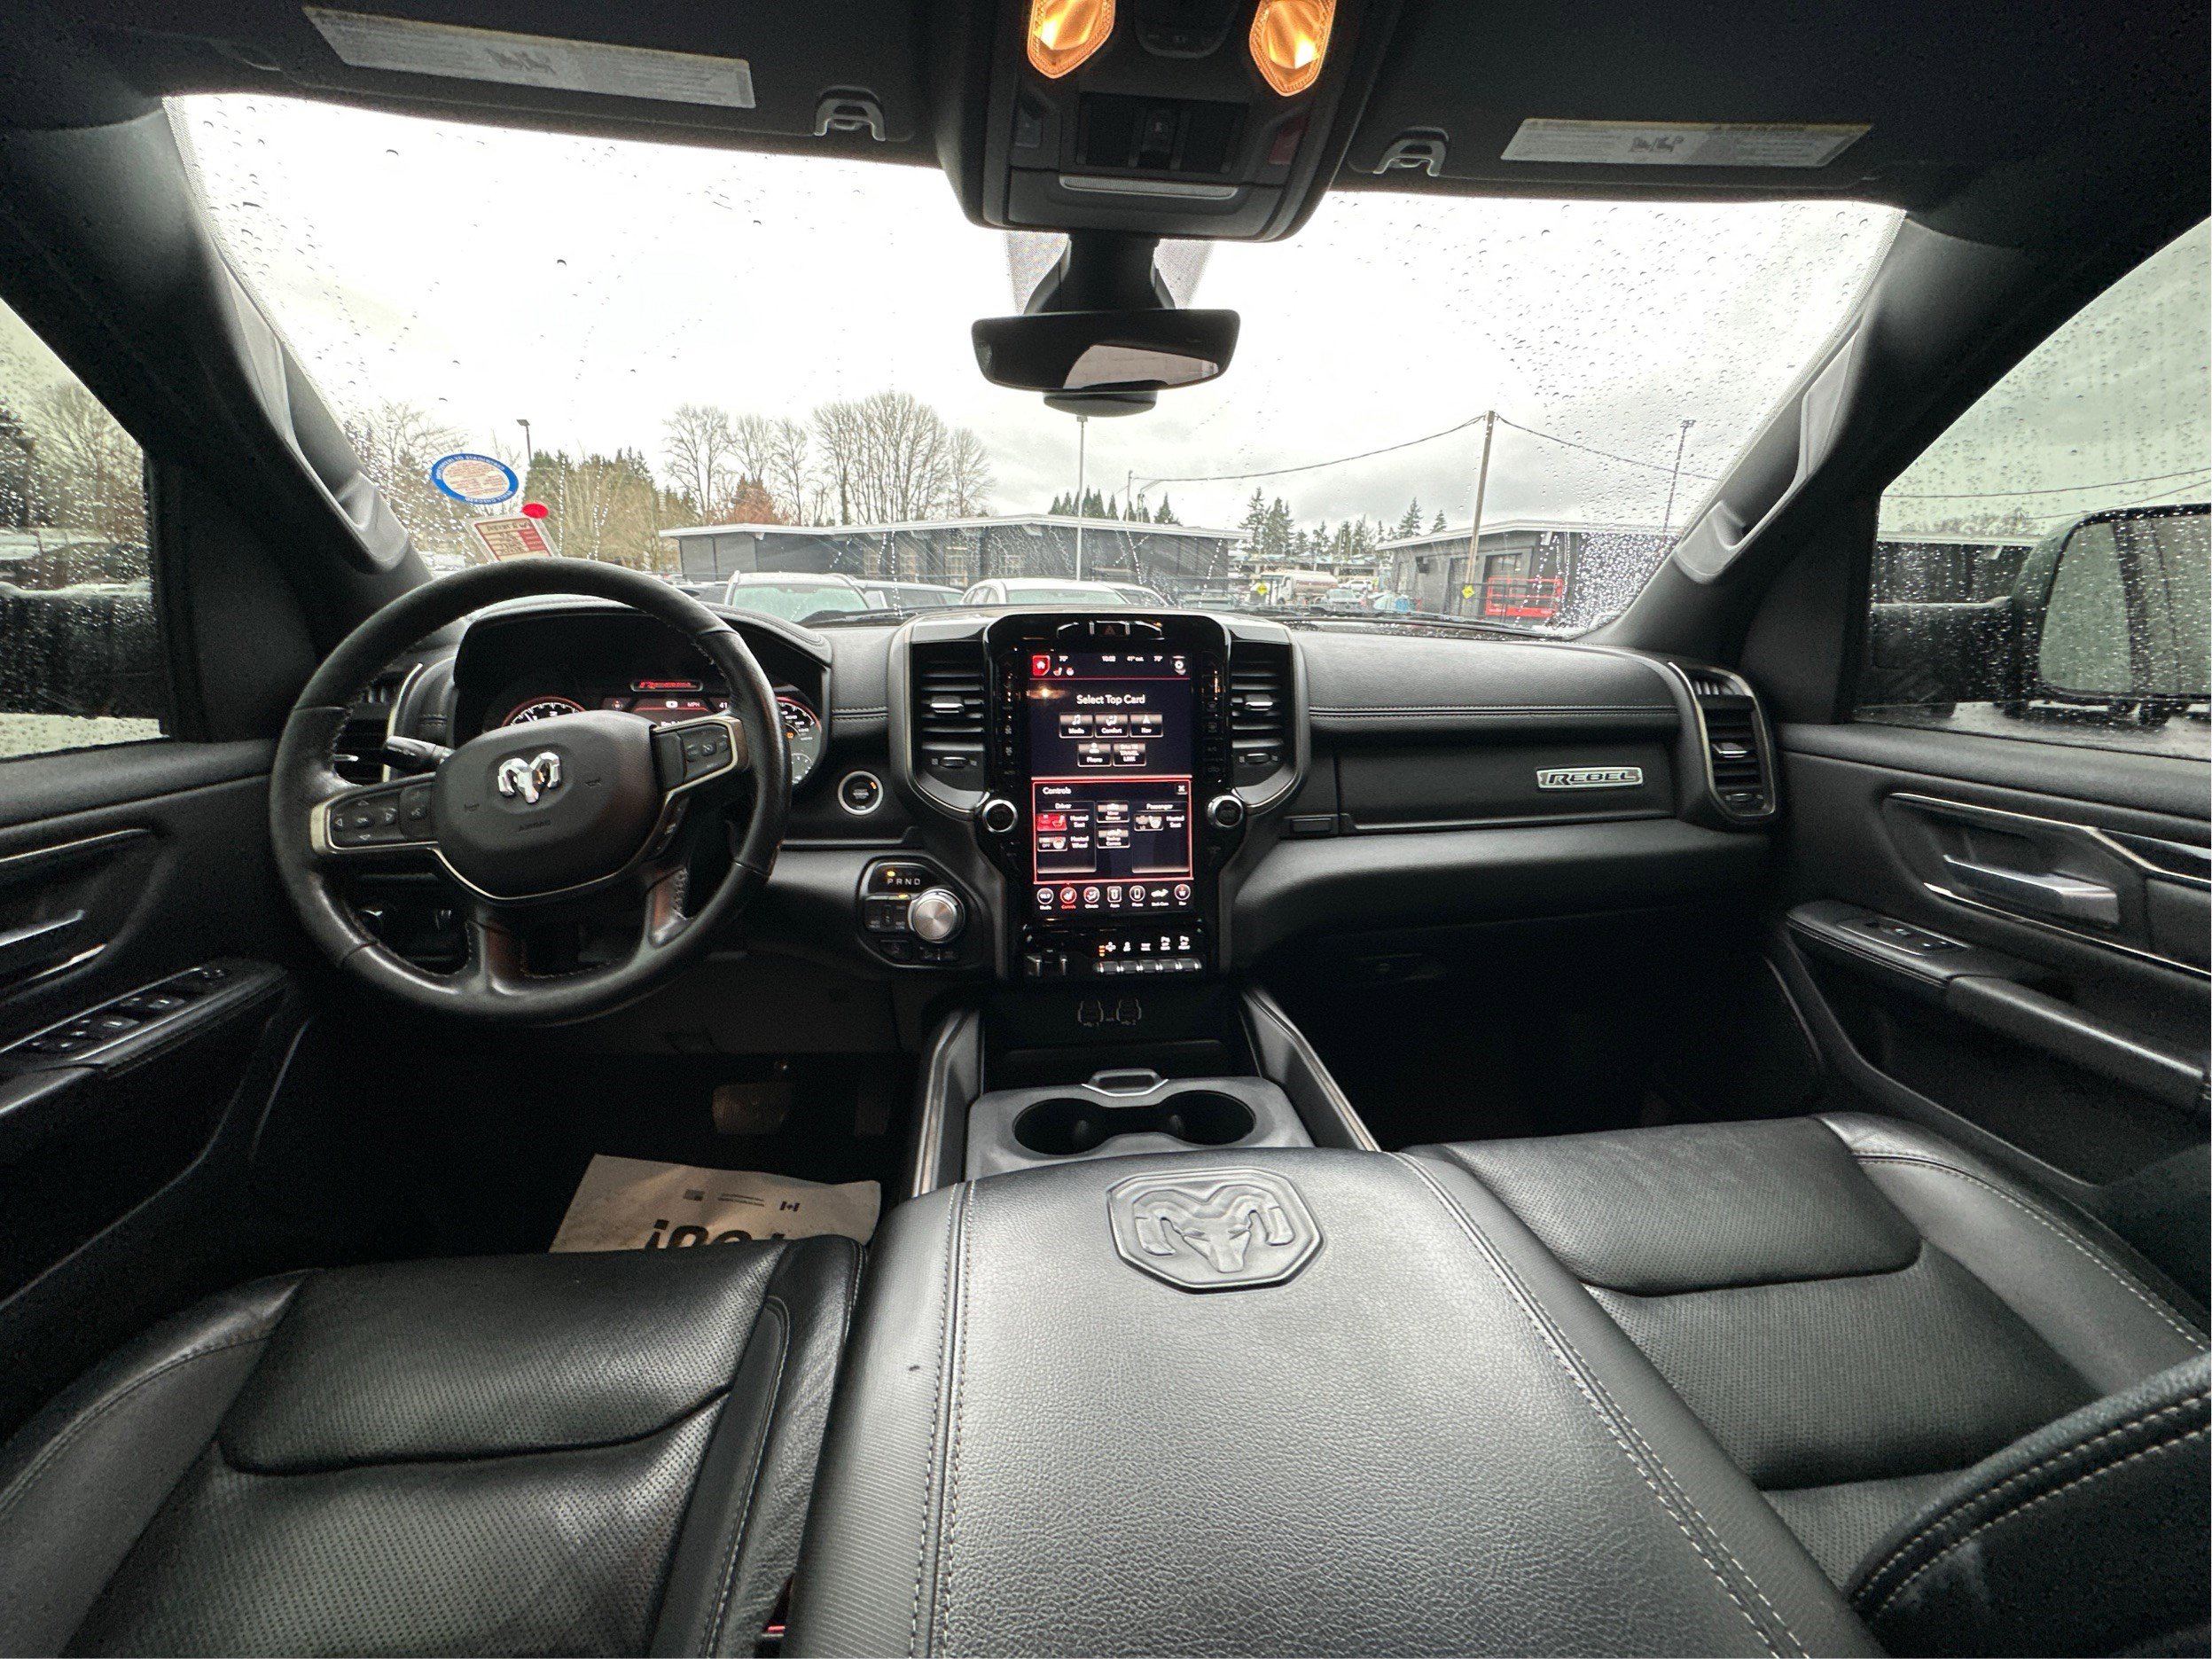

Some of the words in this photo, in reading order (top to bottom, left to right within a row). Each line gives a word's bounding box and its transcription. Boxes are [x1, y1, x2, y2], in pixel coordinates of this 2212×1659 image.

[1076, 694, 1104, 705] Select
[1105, 694, 1122, 706] Top
[1123, 694, 1146, 704] Card
[1547, 771, 1637, 786] REBEL
[1043, 786, 1072, 795] Controls
